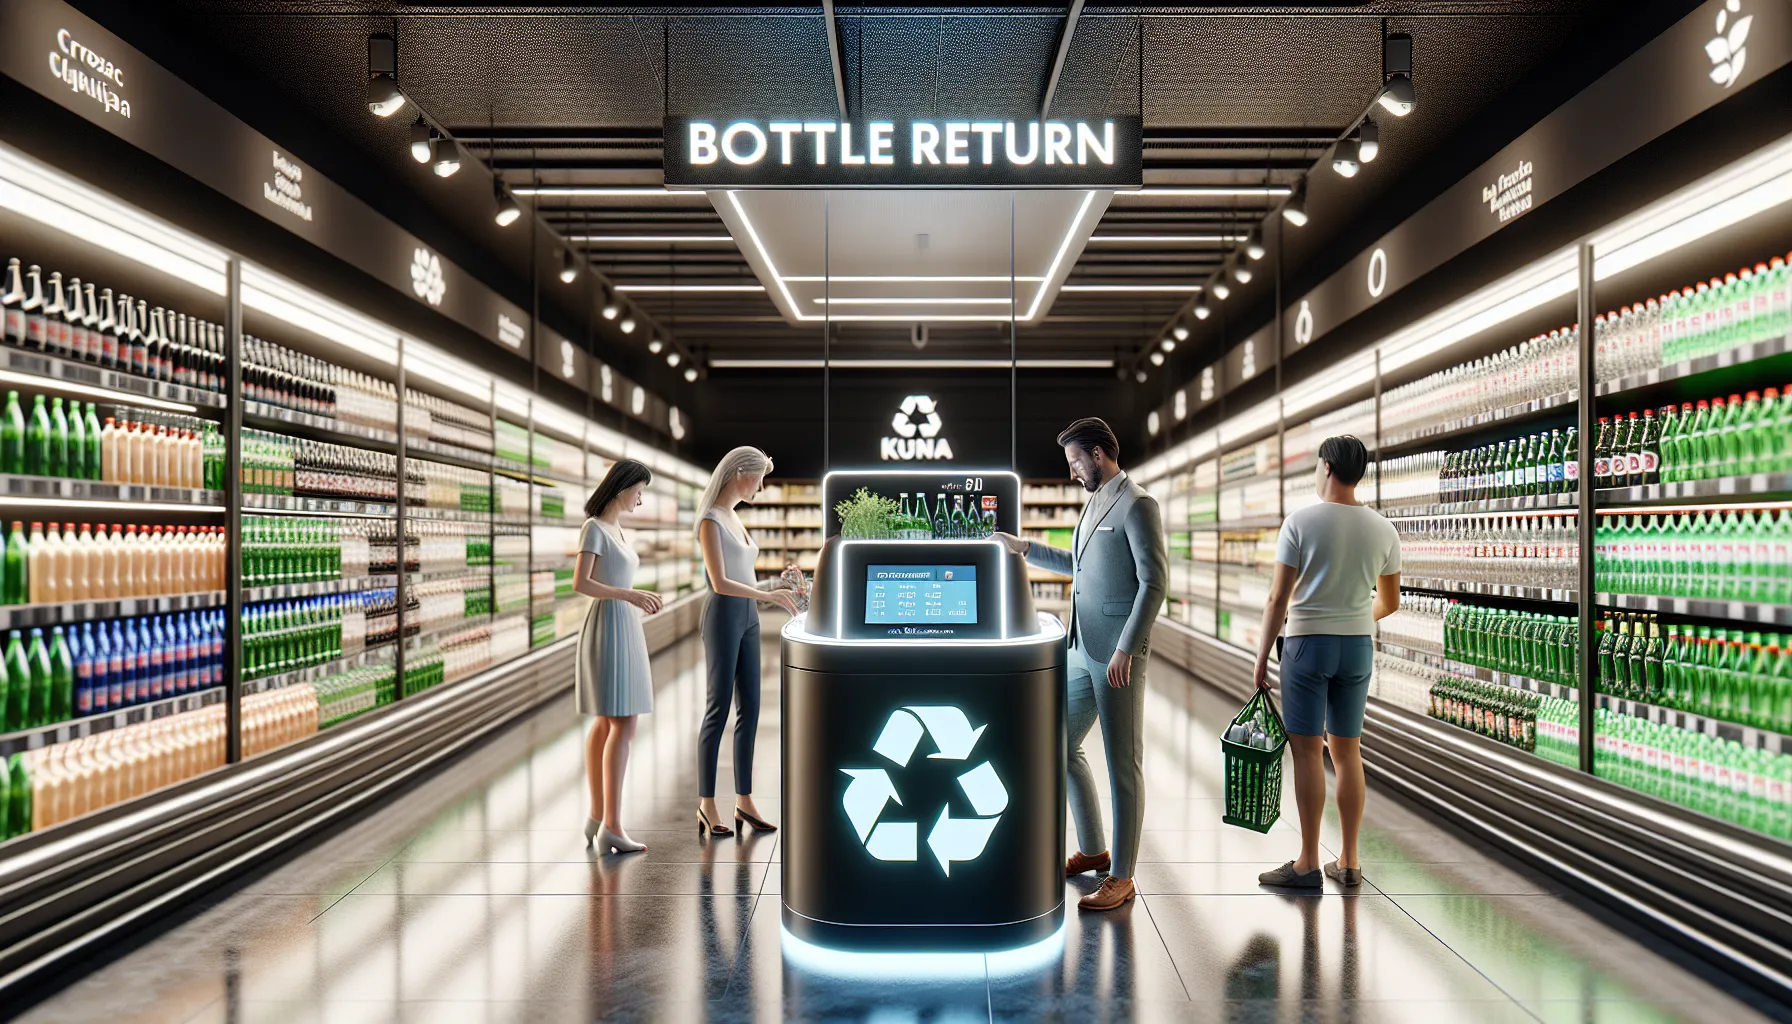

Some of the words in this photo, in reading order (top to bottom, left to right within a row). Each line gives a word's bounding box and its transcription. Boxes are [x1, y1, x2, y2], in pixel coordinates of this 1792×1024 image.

[689, 121, 894, 166] BOTTLE
[912, 121, 1115, 166] RETURN
[880, 436, 954, 461] KUNA
